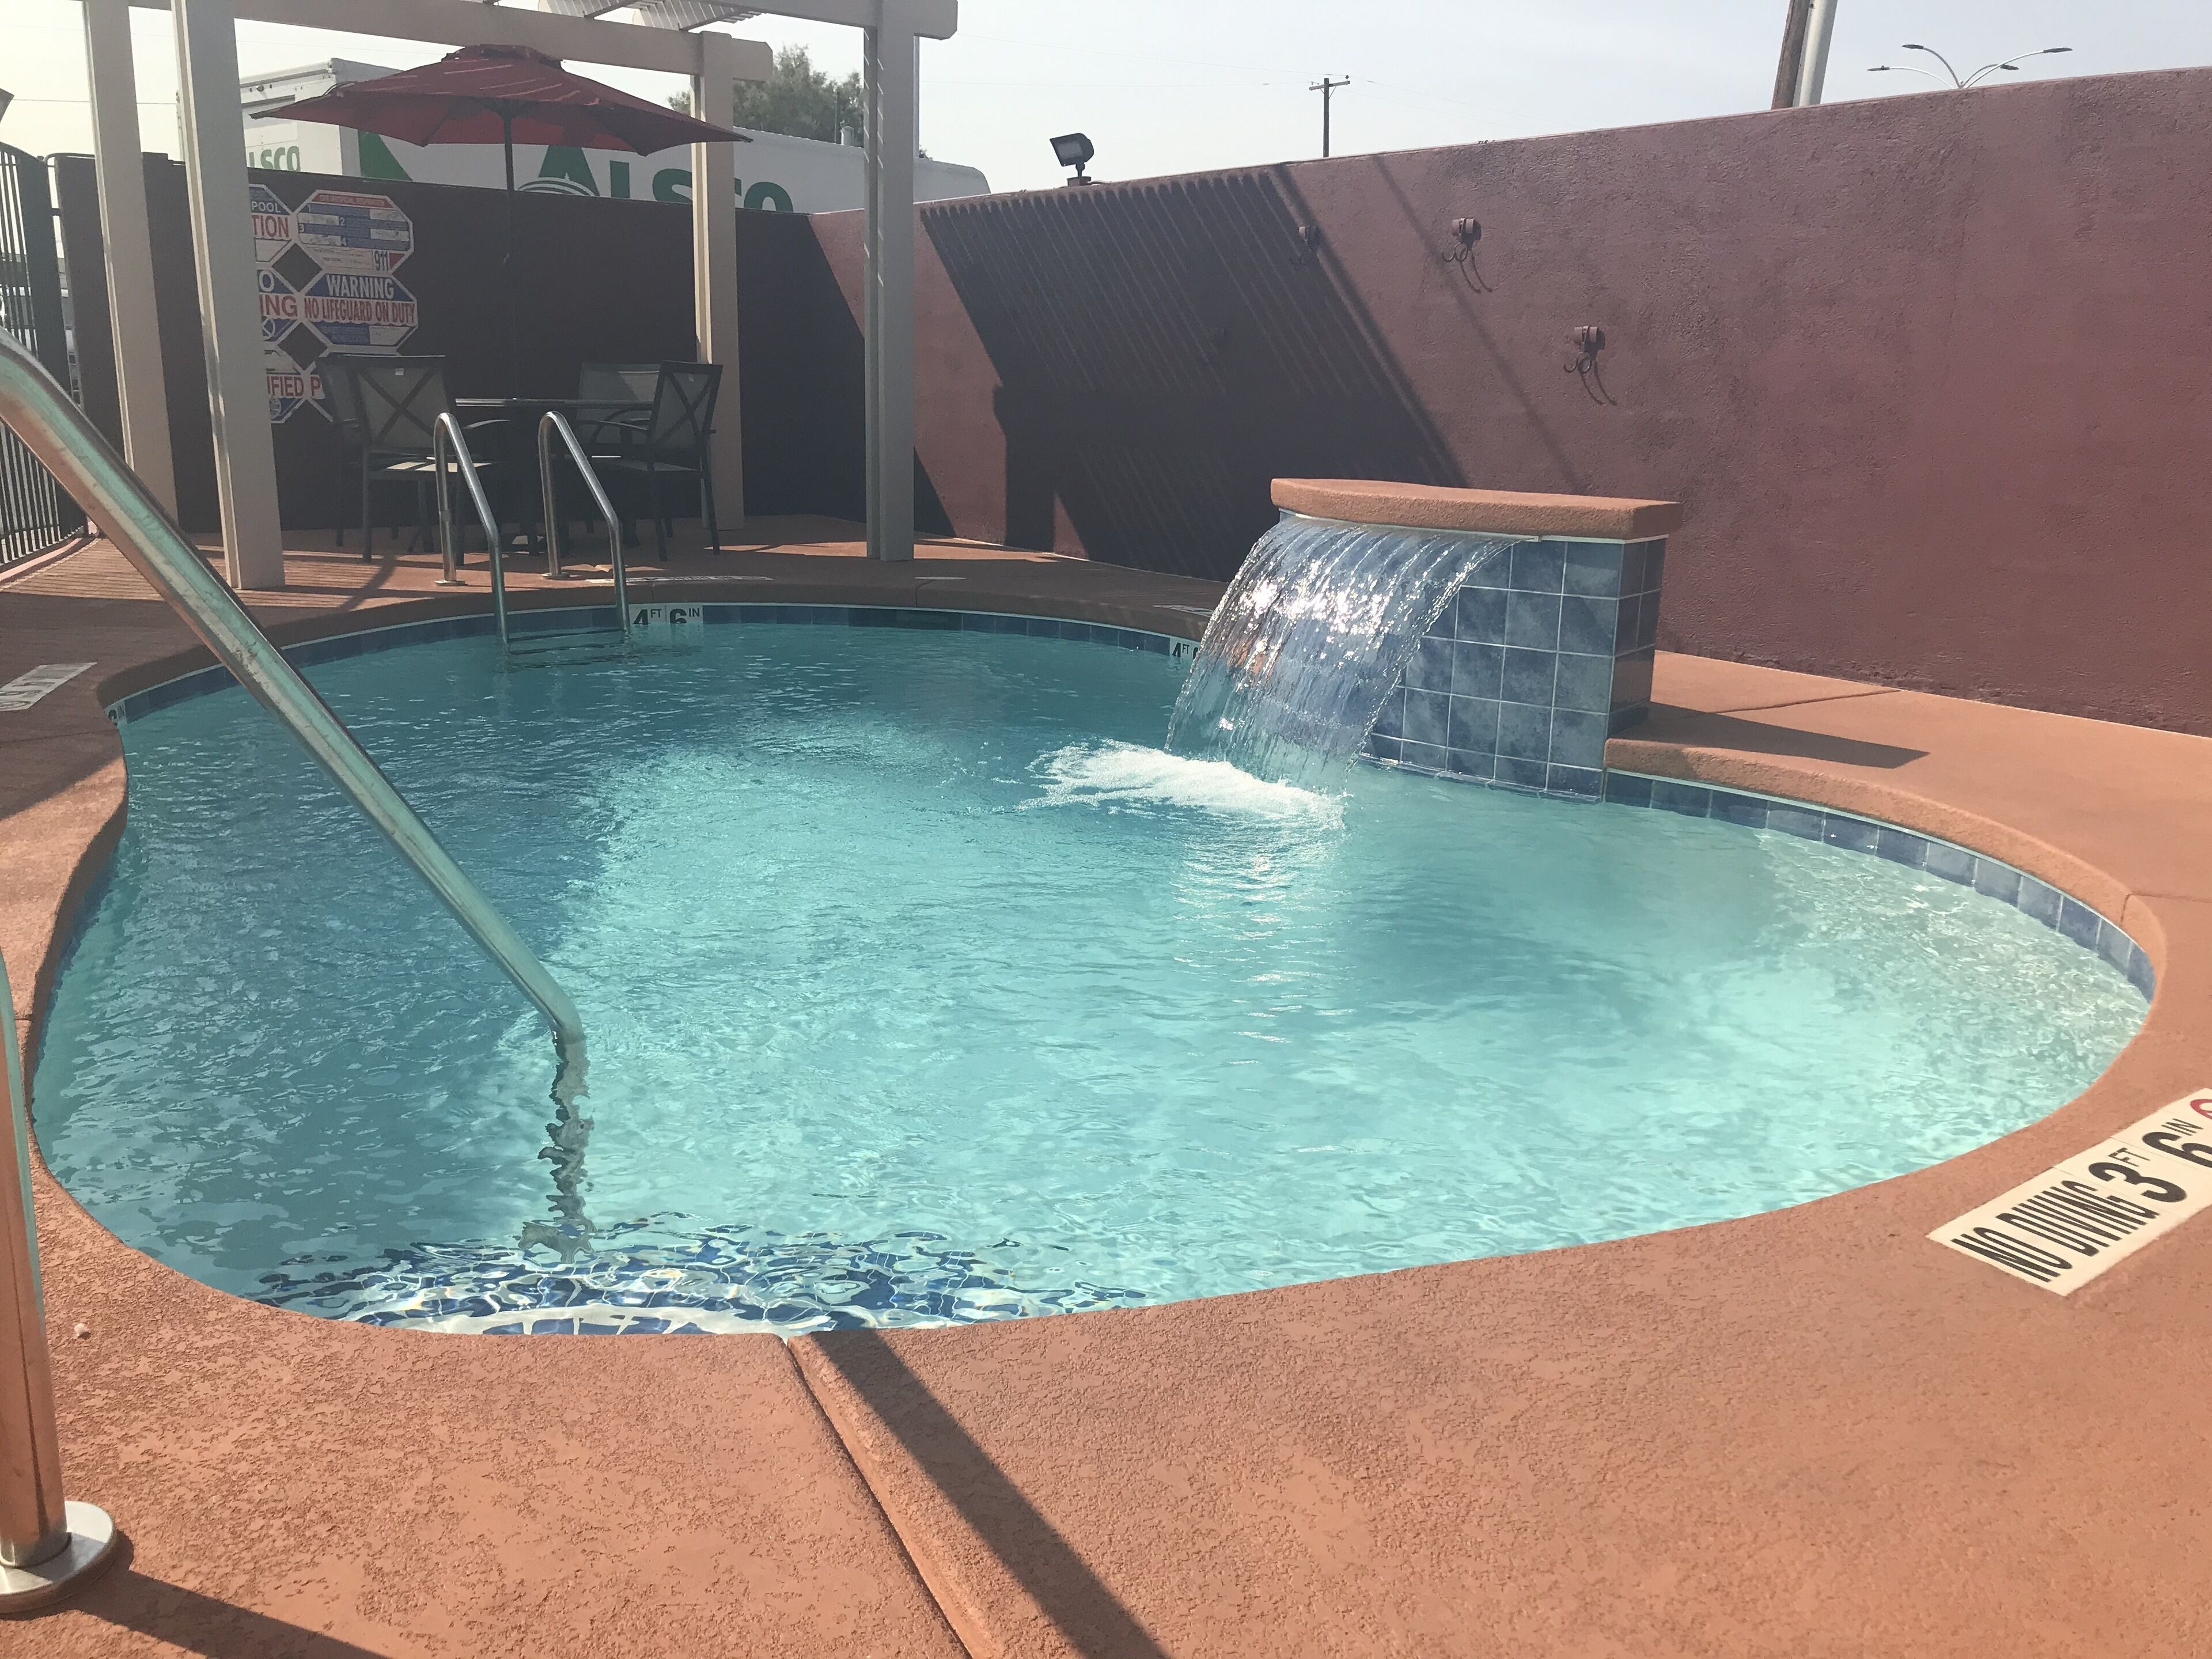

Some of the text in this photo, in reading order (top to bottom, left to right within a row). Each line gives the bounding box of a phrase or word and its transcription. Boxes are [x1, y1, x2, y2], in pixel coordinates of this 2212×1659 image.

[251, 200, 281, 213] POOL
[340, 217, 346, 226] 2
[298, 224, 304, 233] 3
[374, 250, 388, 272] 911
[326, 274, 395, 300] WARNING
[304, 297, 415, 324] NO LIFEGUARD ON DUTY
[651, 608, 662, 618] FT
[688, 608, 700, 618] IN
[1182, 643, 1190, 654] FT
[1950, 1118, 2212, 1283] NO DIVING 3 FT 6 IN
